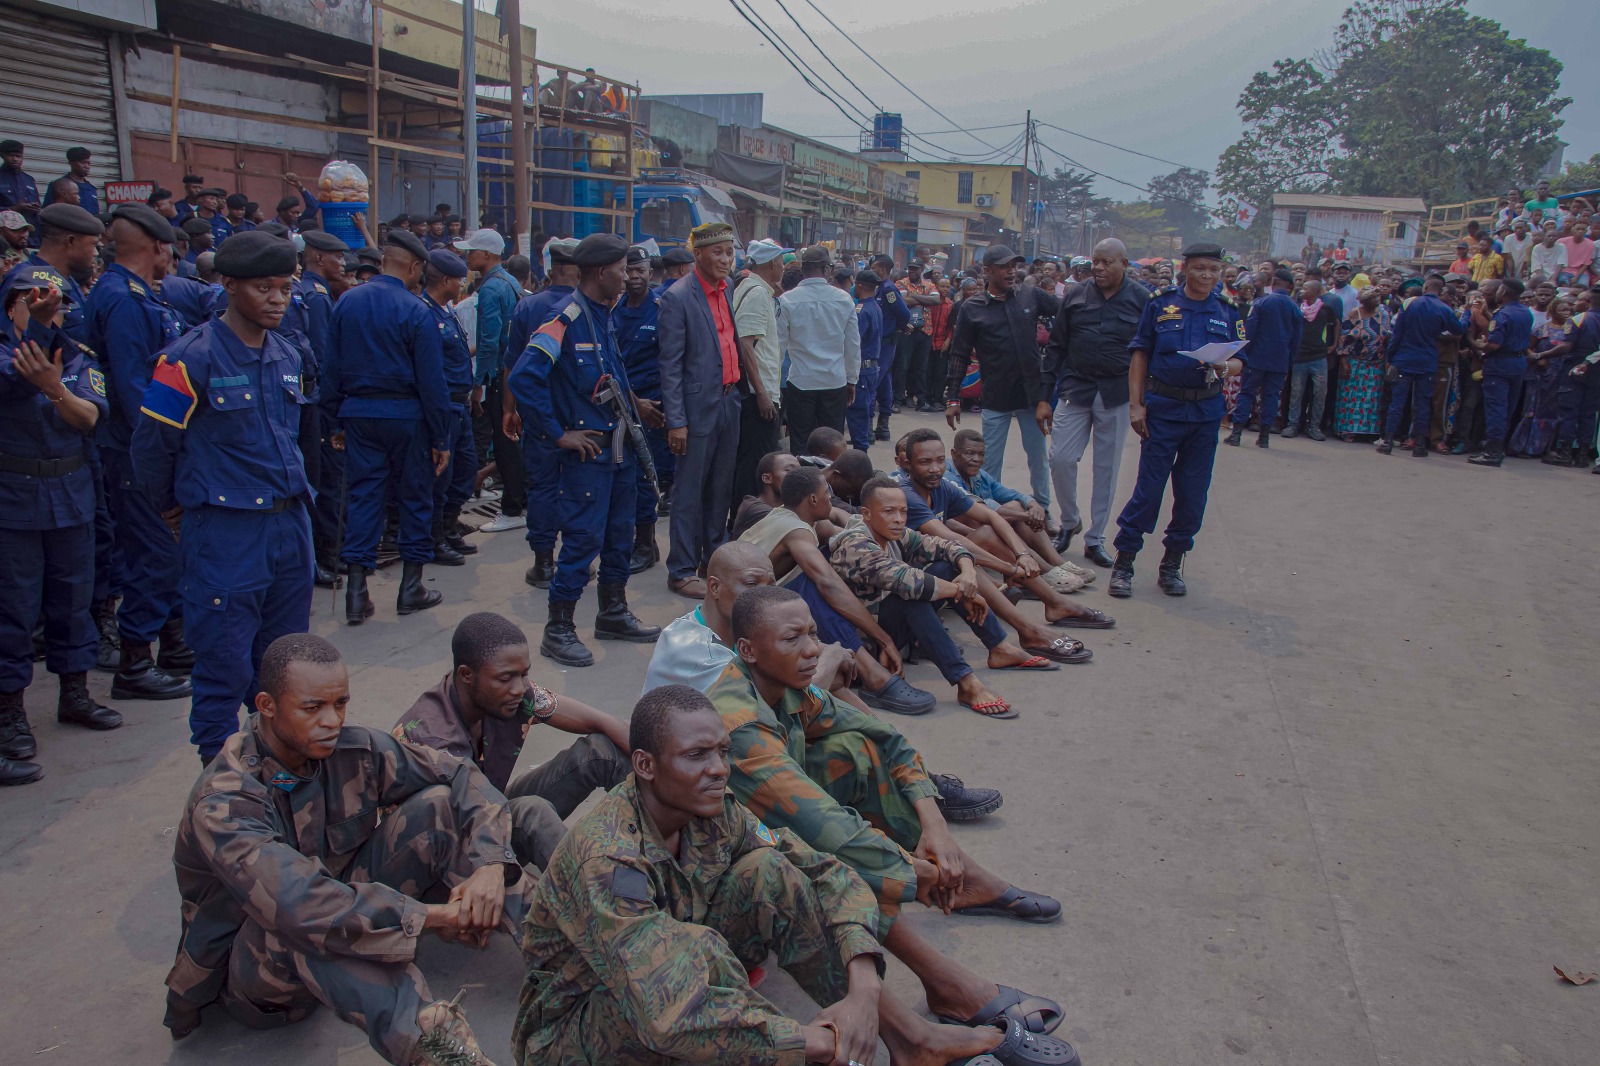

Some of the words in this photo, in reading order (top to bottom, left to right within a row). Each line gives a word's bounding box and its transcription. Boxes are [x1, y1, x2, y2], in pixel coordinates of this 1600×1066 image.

[107, 185, 153, 201] CHANGE
[32, 271, 63, 287] POLCE
[1209, 318, 1228, 328] POLICE
[61, 374, 79, 383] OLIC
[282, 374, 299, 384] POLIC
